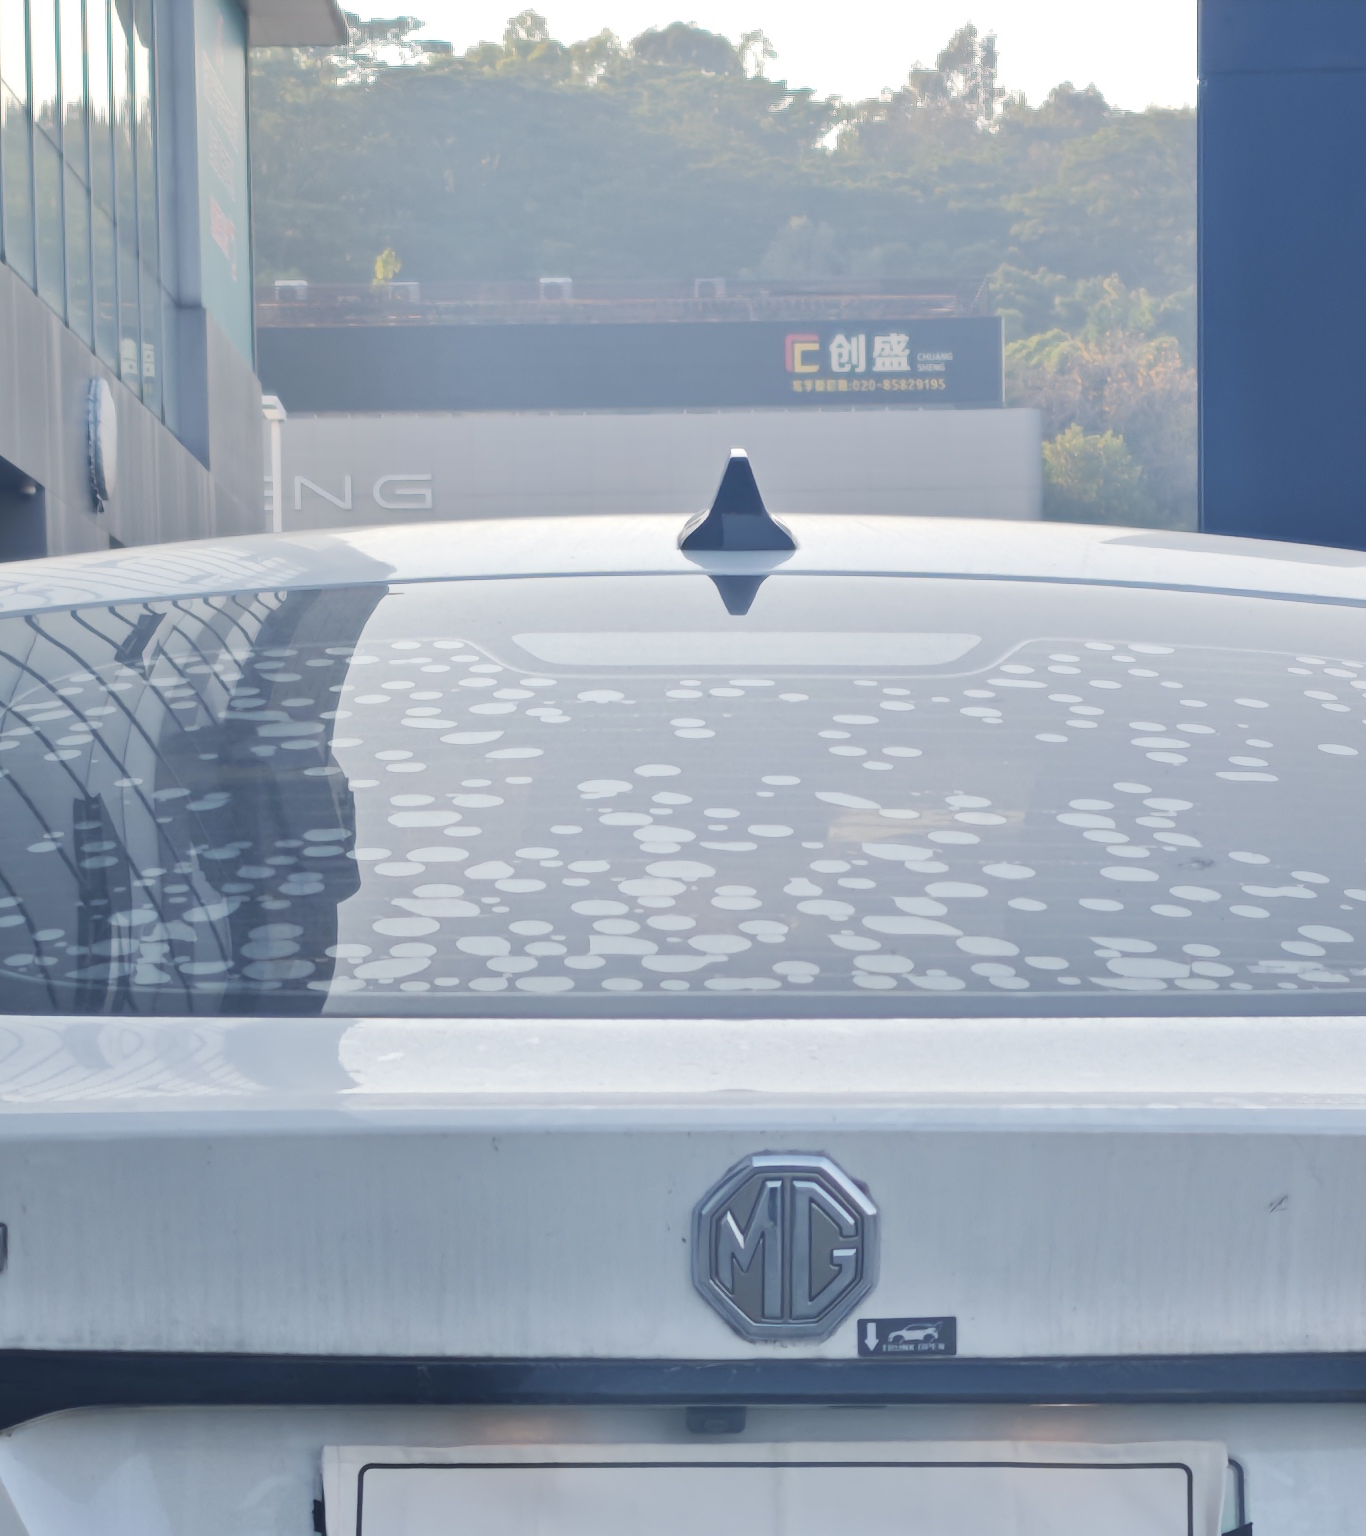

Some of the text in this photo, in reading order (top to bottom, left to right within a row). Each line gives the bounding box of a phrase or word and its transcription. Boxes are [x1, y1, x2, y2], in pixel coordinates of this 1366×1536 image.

[829, 333, 911, 373] 创盛
[263, 474, 433, 511] NG
[709, 1174, 863, 1326] MG
